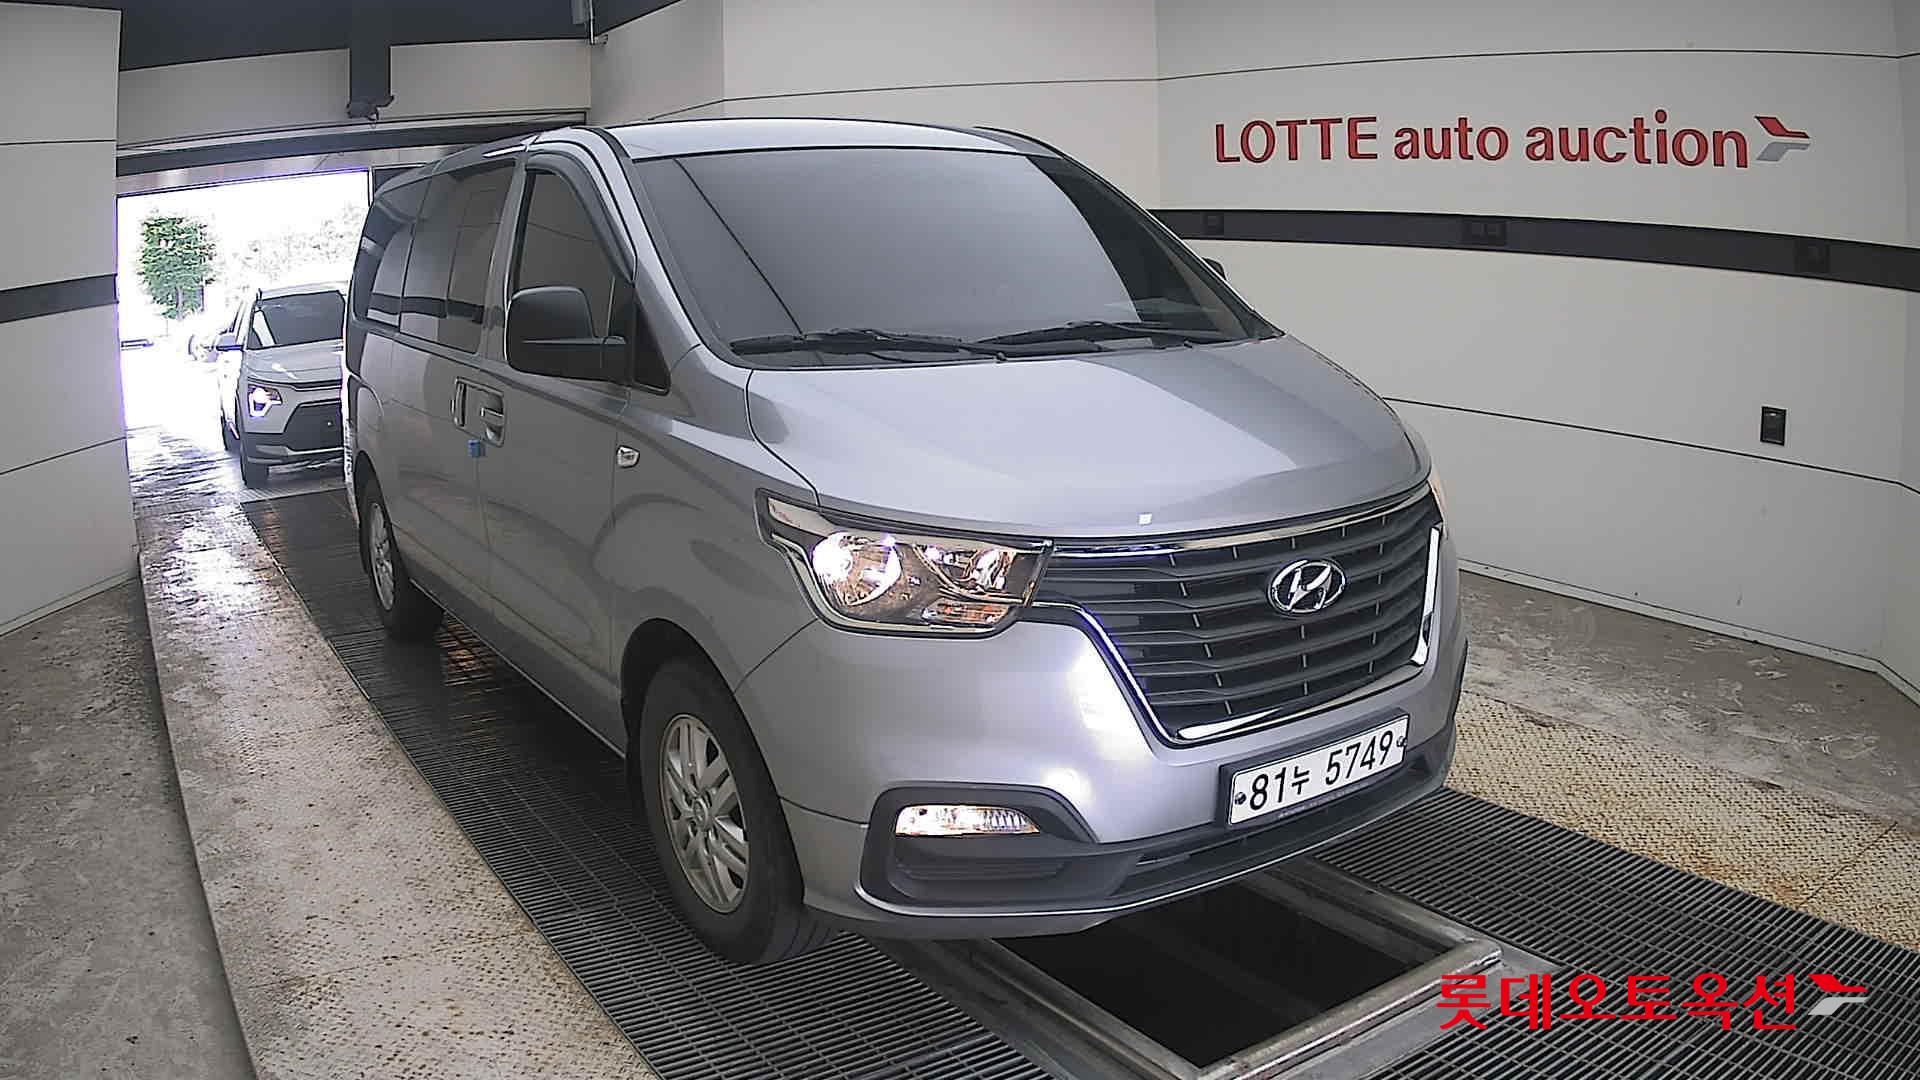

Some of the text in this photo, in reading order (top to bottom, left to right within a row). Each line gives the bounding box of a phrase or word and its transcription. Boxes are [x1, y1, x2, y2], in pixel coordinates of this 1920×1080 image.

[1215, 109, 1748, 169] LOTTE auto auction
[1249, 766, 1310, 811] 81누
[1325, 730, 1394, 786] 5749
